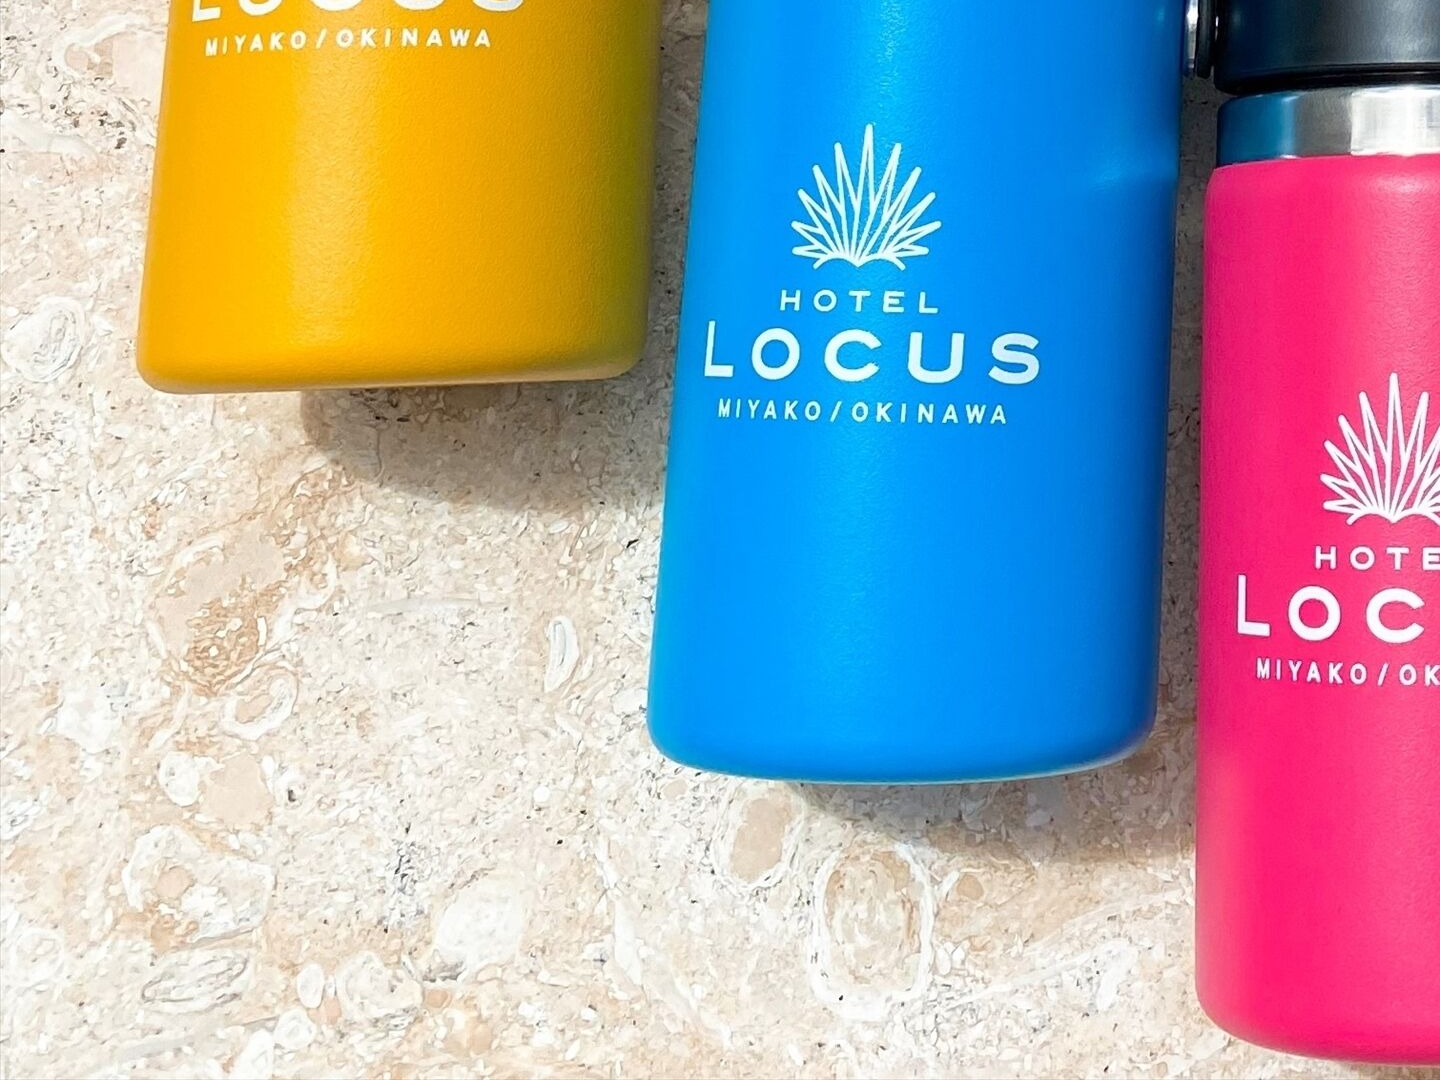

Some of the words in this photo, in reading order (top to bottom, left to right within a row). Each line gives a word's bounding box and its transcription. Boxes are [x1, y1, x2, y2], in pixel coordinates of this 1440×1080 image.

[205, 27, 491, 57] MIYAKO/OKINAWA
[779, 289, 940, 314] HOTEL
[704, 320, 1041, 385] LOCUS
[717, 397, 1007, 424] MIYAKO/OKINAWA
